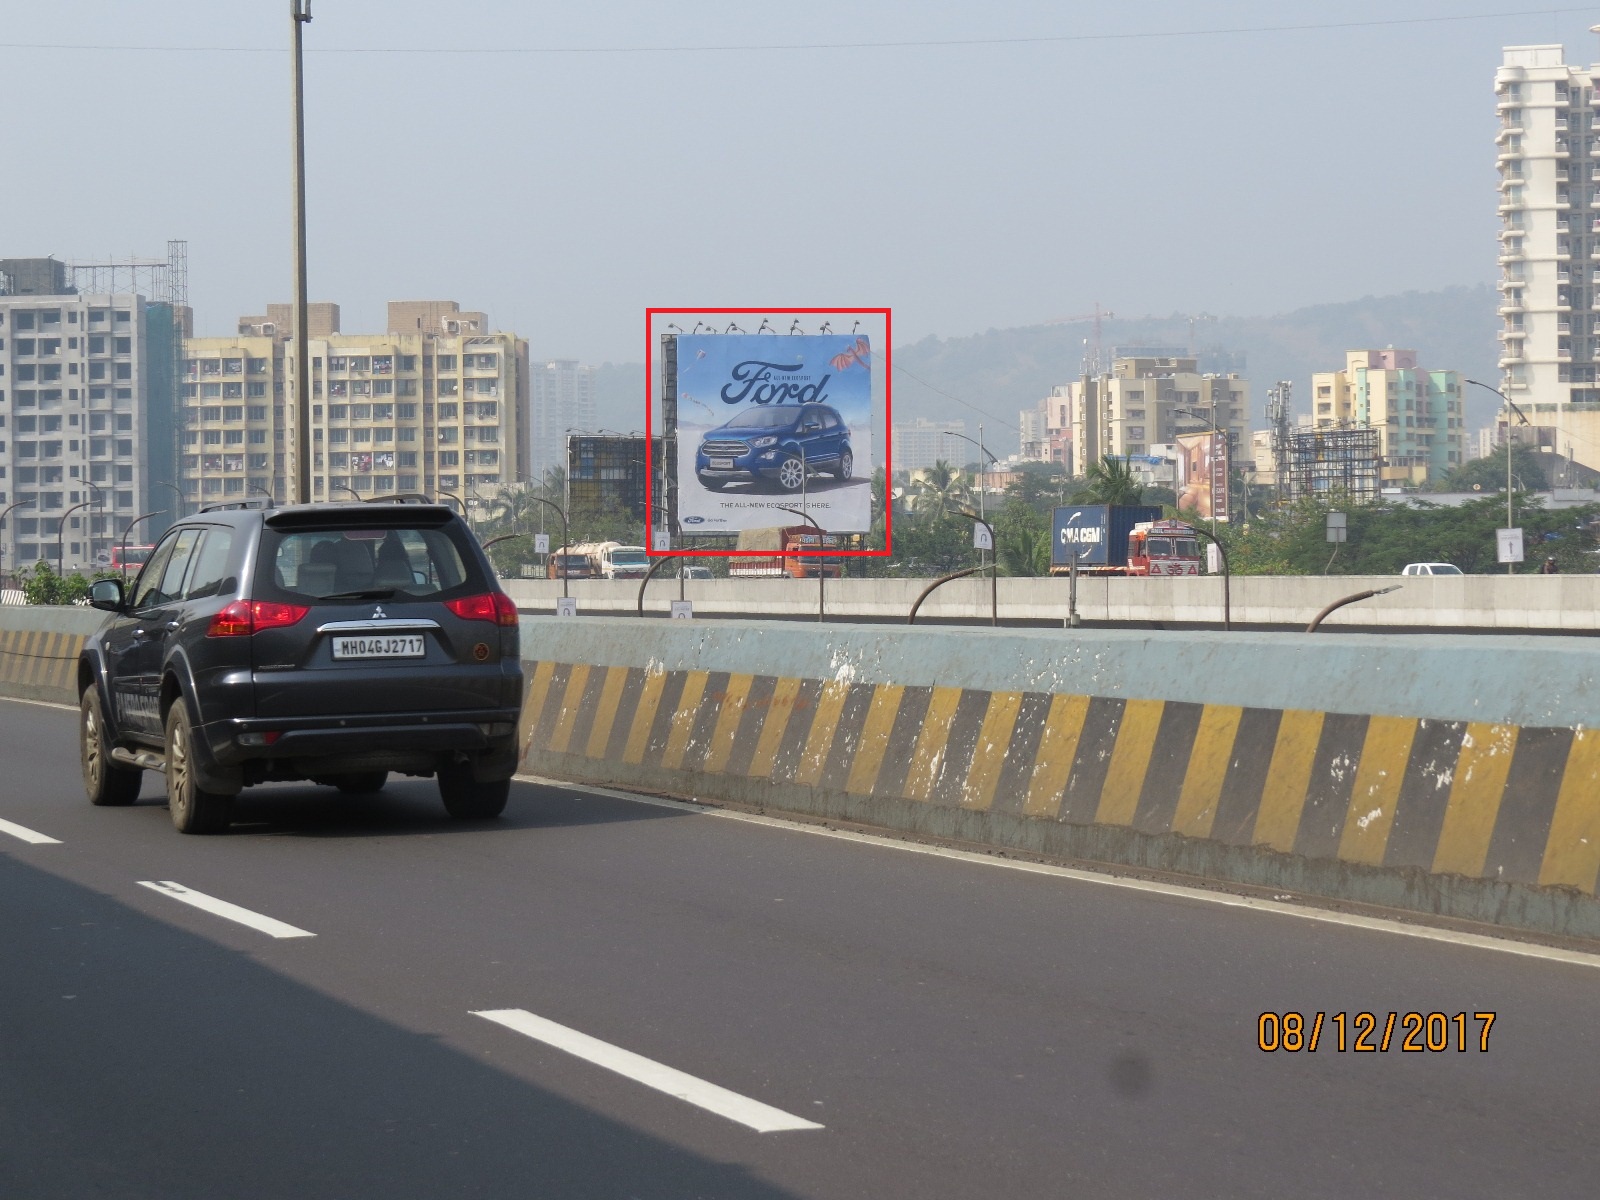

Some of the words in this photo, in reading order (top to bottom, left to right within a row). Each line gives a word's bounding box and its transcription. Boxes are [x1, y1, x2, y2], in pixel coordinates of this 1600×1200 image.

[721, 361, 831, 404] Ford
[1061, 528, 1079, 544] CMA
[1080, 527, 1100, 543] CGM
[342, 639, 424, 655] MH04GJ2717
